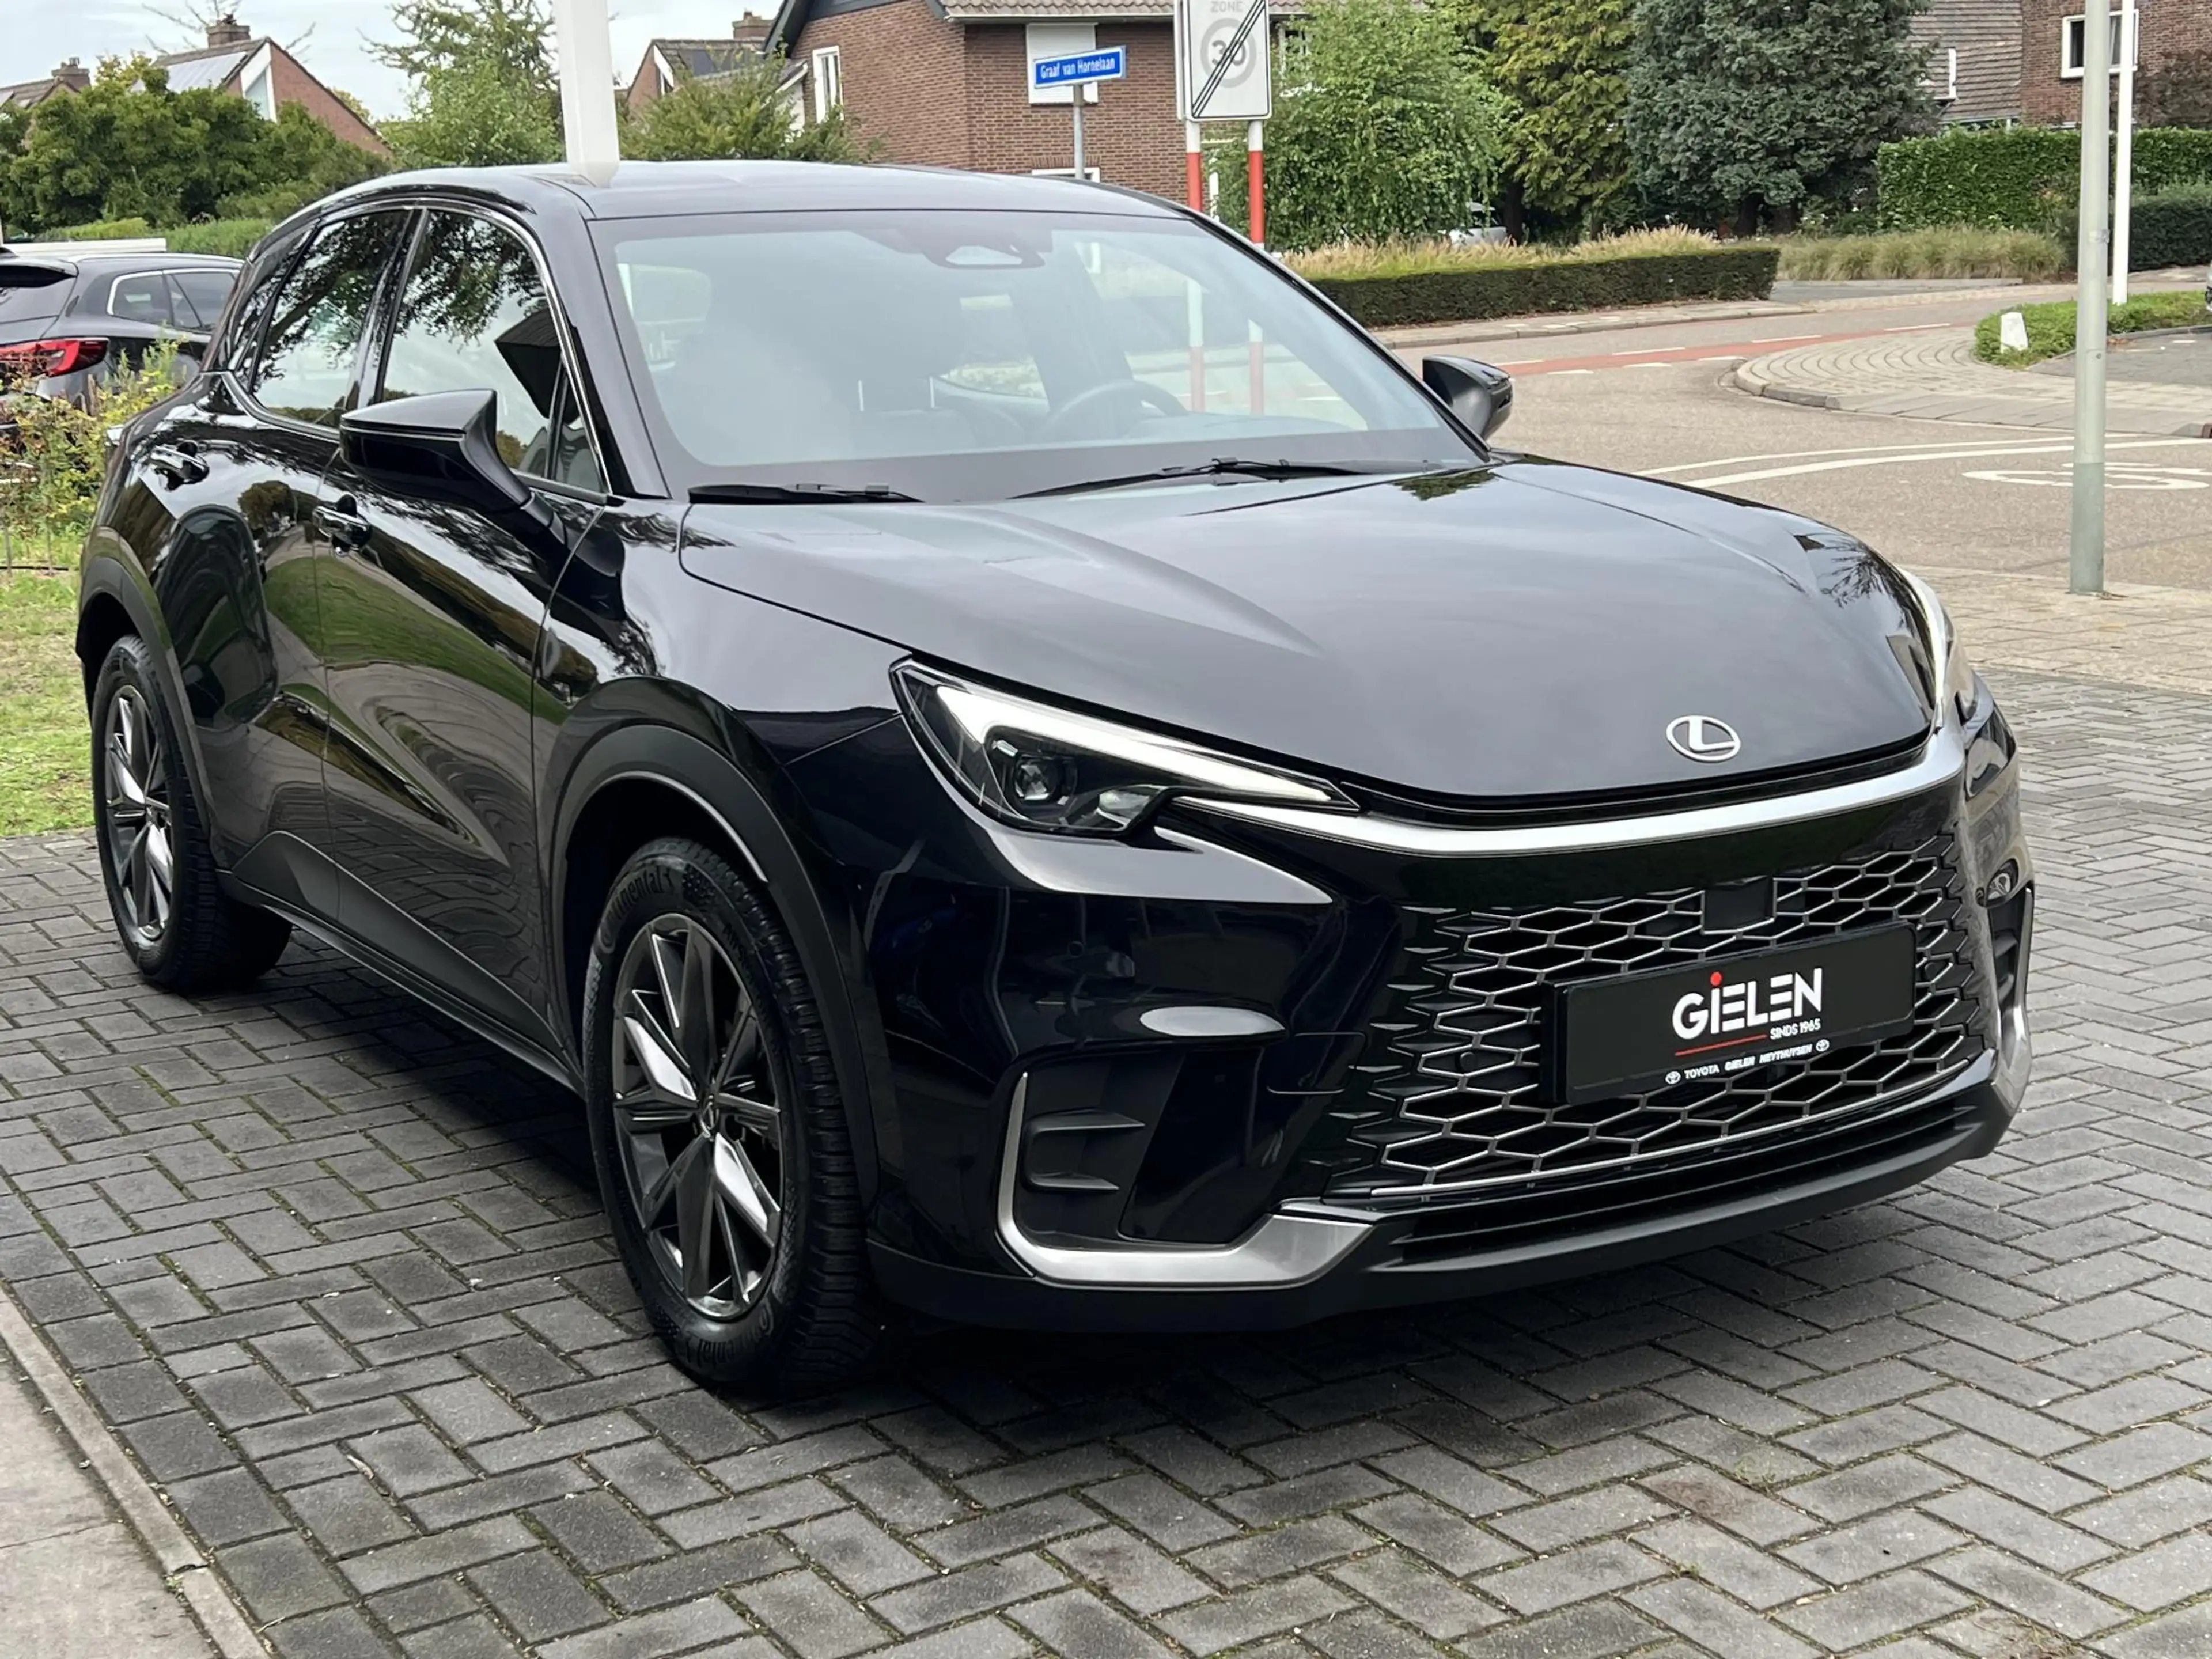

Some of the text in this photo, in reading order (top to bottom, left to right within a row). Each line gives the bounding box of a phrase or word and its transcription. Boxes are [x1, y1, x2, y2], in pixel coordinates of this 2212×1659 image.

[1210, 1, 1243, 13] ZONE
[1212, 40, 1247, 66] 30
[1040, 56, 1116, 79] Graaf van Hornelaan
[1770, 1018, 1821, 1040] SINDS 1965
[1684, 1064, 1720, 1080] TOYOTA
